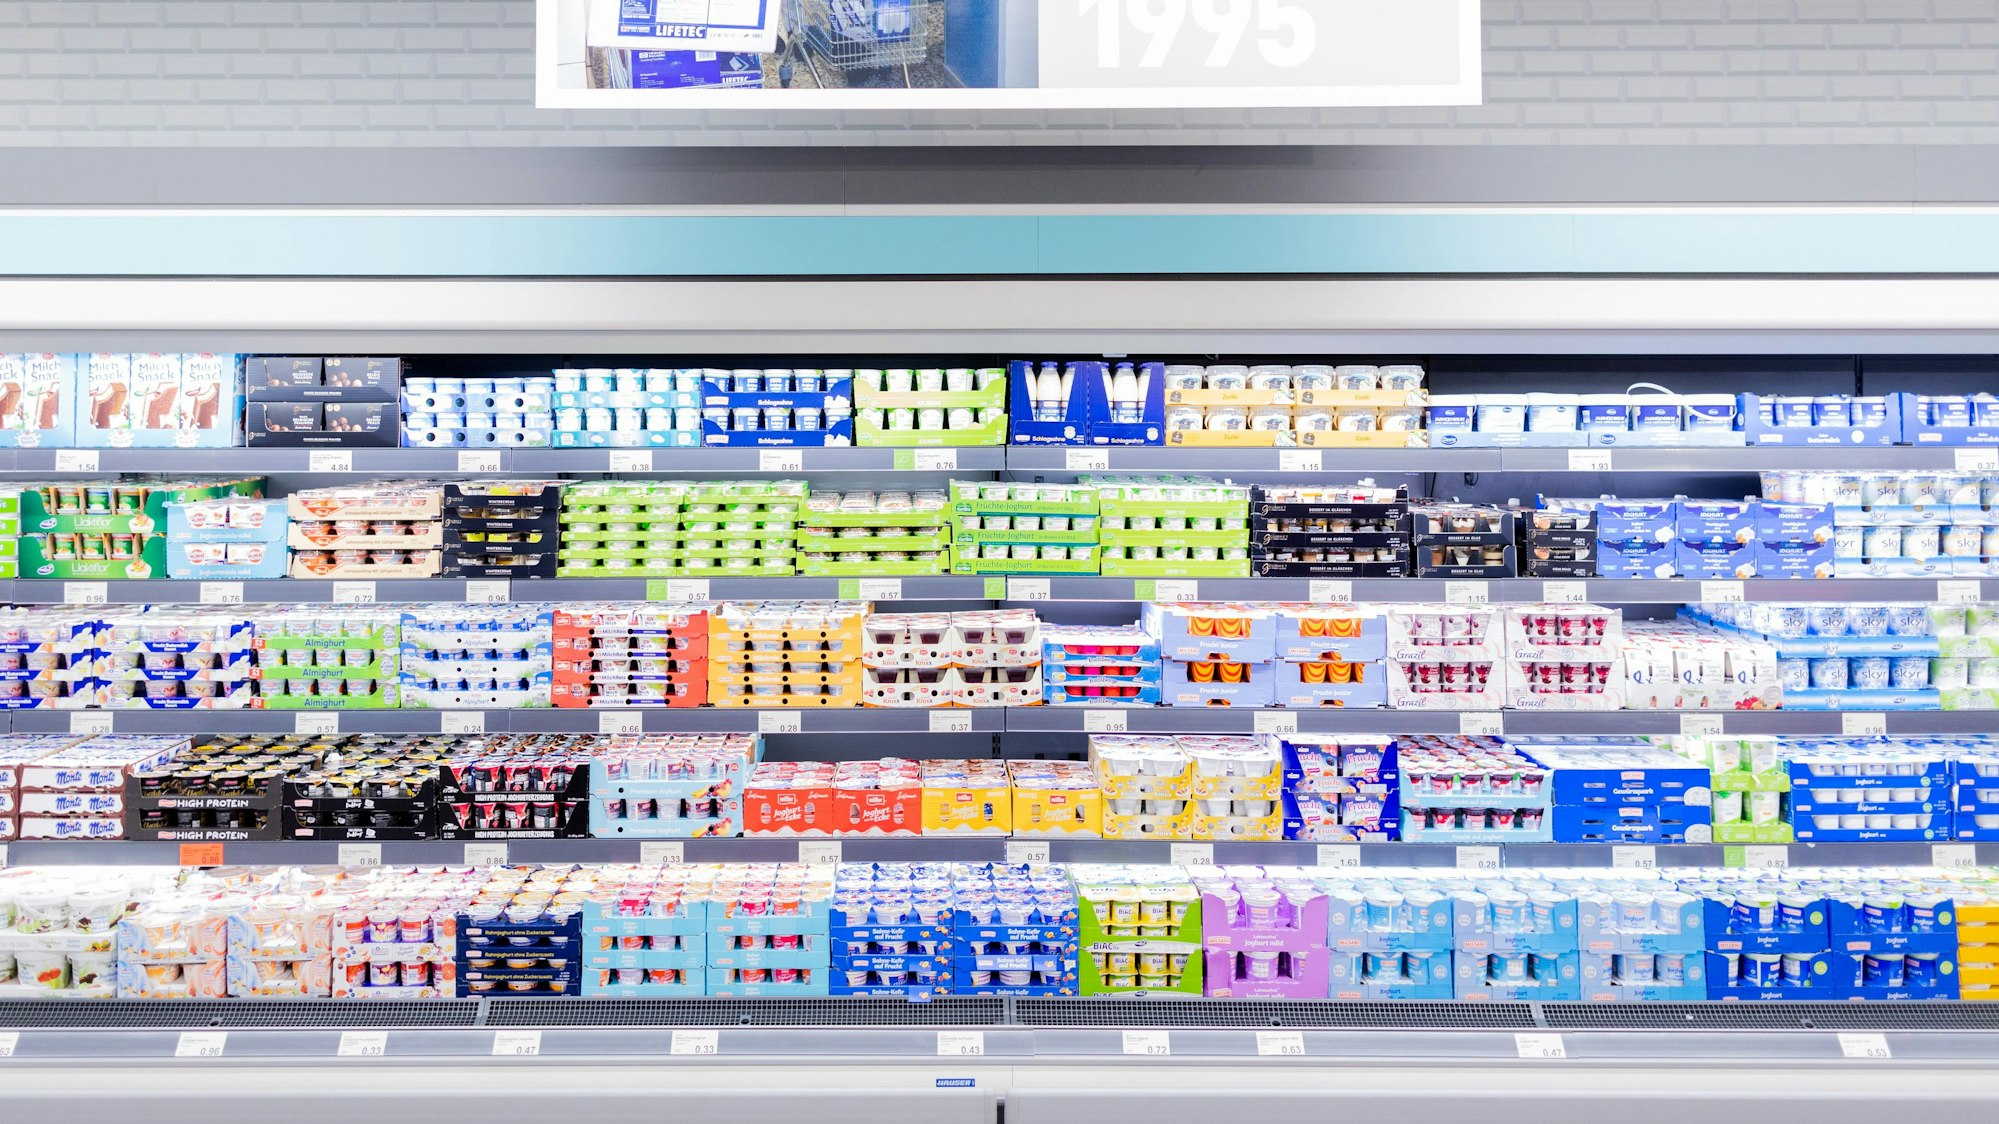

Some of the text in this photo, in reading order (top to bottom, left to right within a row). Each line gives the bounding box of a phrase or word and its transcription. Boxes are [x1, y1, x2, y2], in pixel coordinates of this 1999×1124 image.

[656, 25, 705, 38] LIFETEC
[1078, 0, 1317, 67] 1995
[937, 462, 954, 470] 0.76
[1592, 463, 1609, 471] 1.93
[1978, 462, 1995, 470] 0.37
[1833, 486, 1859, 496] skyr
[1870, 511, 1887, 520] skyr
[1870, 563, 1887, 572] skyr
[86, 595, 104, 603] 0.96
[222, 595, 240, 603] 0.76
[355, 595, 372, 603] 0.72
[881, 592, 898, 600] 0.57
[1030, 592, 1047, 600] 0.37
[1331, 594, 1349, 602] 0.96
[1566, 594, 1583, 602] 1.44
[1960, 594, 1978, 602] 1.15
[305, 639, 346, 648] Almighurt
[1397, 649, 1426, 660] Grazil
[1515, 648, 1544, 659] Grazil
[303, 669, 344, 678] Almighurt
[1861, 669, 1886, 679] skyr
[1895, 668, 1922, 679] skyr
[304, 698, 346, 708] Almighurt
[1397, 696, 1426, 707] Grazil
[1517, 696, 1546, 707] Grazil
[92, 725, 110, 733] 0.28
[317, 725, 334, 733] 0.57
[464, 725, 482, 733] 0.24
[780, 724, 798, 732] 0.28
[951, 724, 968, 732] 0.37
[1276, 725, 1294, 733] 0.66
[1865, 727, 1883, 735] 0.96
[1346, 752, 1379, 764] Frucht
[56, 771, 82, 784] Monte
[89, 771, 115, 784] Monte
[475, 794, 486, 802] HIGH
[487, 794, 506, 802] PROTEIN
[56, 796, 82, 810] Monte
[89, 796, 115, 810] Monte
[176, 799, 248, 807] HIGH PROTEIN
[1346, 800, 1379, 812] Frucht
[774, 807, 800, 818] Joghurt
[862, 807, 889, 818] Joghurt
[56, 820, 82, 835] Monte
[89, 820, 115, 835] Monte
[206, 831, 248, 839] PROTEIN
[202, 856, 220, 864] 0.96
[487, 857, 504, 865] 0.86
[821, 855, 838, 863] 0.57
[1479, 860, 1496, 868] 0.28
[1635, 860, 1652, 868] 0.57
[1757, 936, 1779, 944] Joghurt
[1093, 942, 1113, 950] BiAC
[1761, 992, 1782, 1000] Joghurt
[1887, 992, 1908, 1000] Joghurt
[200, 1048, 220, 1056] 0.96
[362, 1047, 381, 1055] 0.33
[695, 1046, 714, 1054] 0.33
[961, 1046, 980, 1054] 0.43
[1148, 1046, 1167, 1054] 0.72
[1281, 1046, 1301, 1054] 0.63
[1543, 1048, 1562, 1057] 0.47
[1867, 1048, 1887, 1057] 0.53
